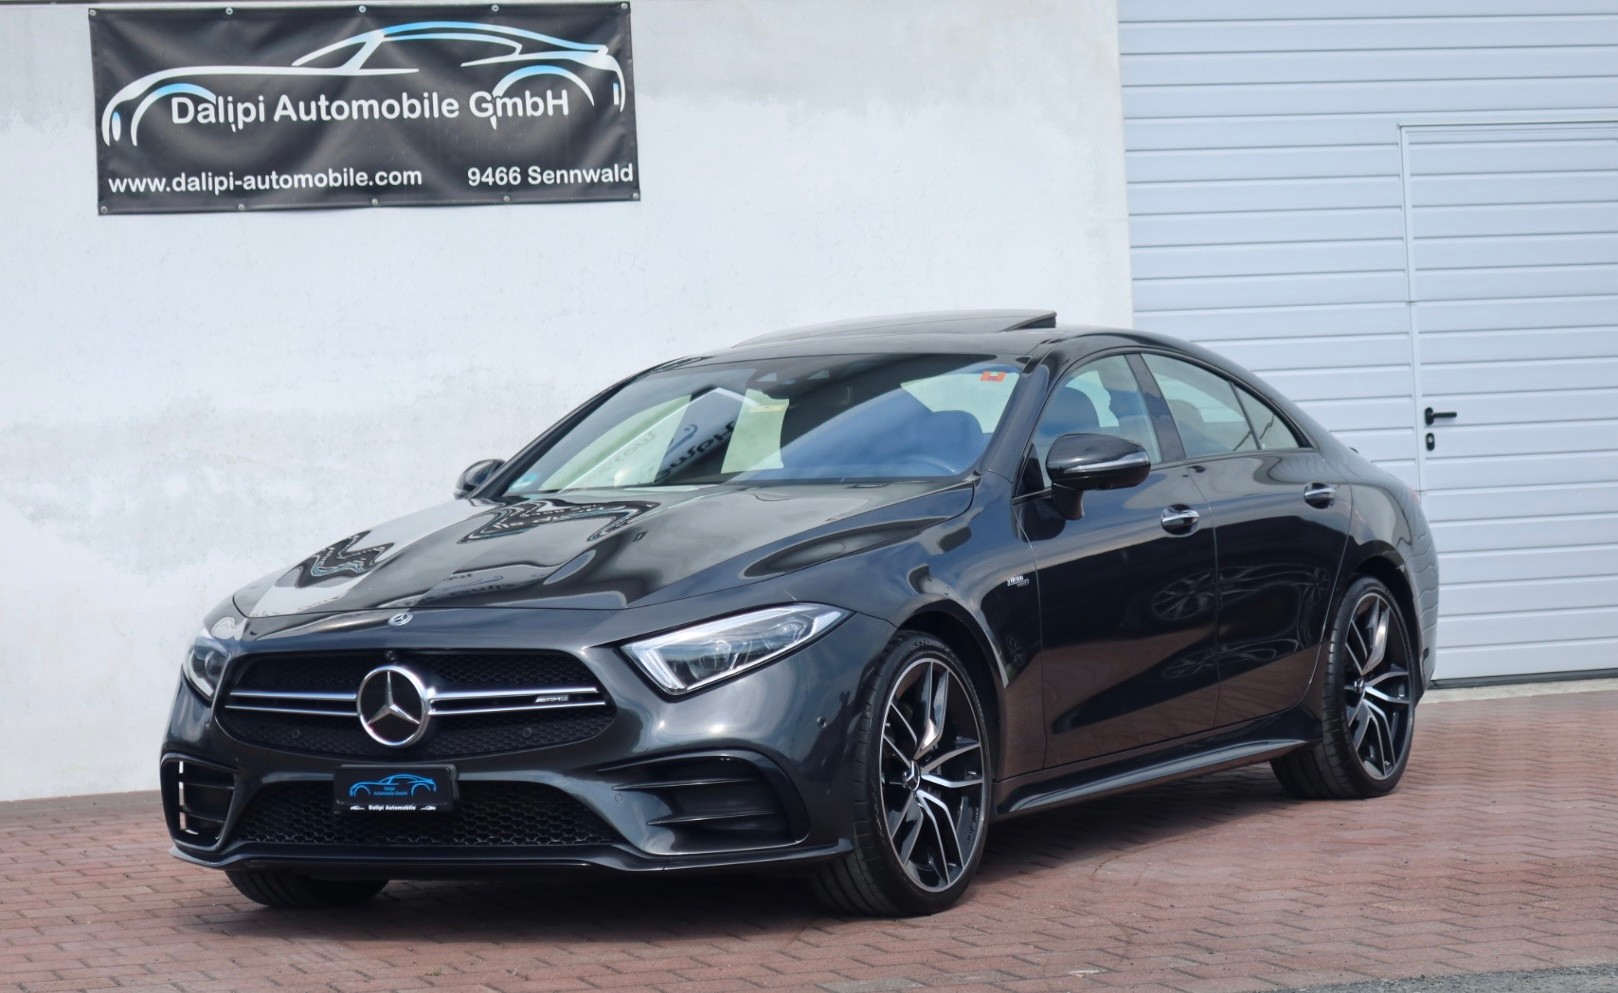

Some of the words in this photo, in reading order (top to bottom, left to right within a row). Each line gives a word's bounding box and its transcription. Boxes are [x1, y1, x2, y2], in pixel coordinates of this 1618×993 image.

[171, 95, 266, 130] Dalipi
[273, 92, 460, 122] Automobile
[469, 89, 569, 118] GmbH
[108, 168, 423, 196] www.dalipi-automobile.com
[467, 166, 522, 187] 9466
[527, 163, 634, 185] Sennwald
